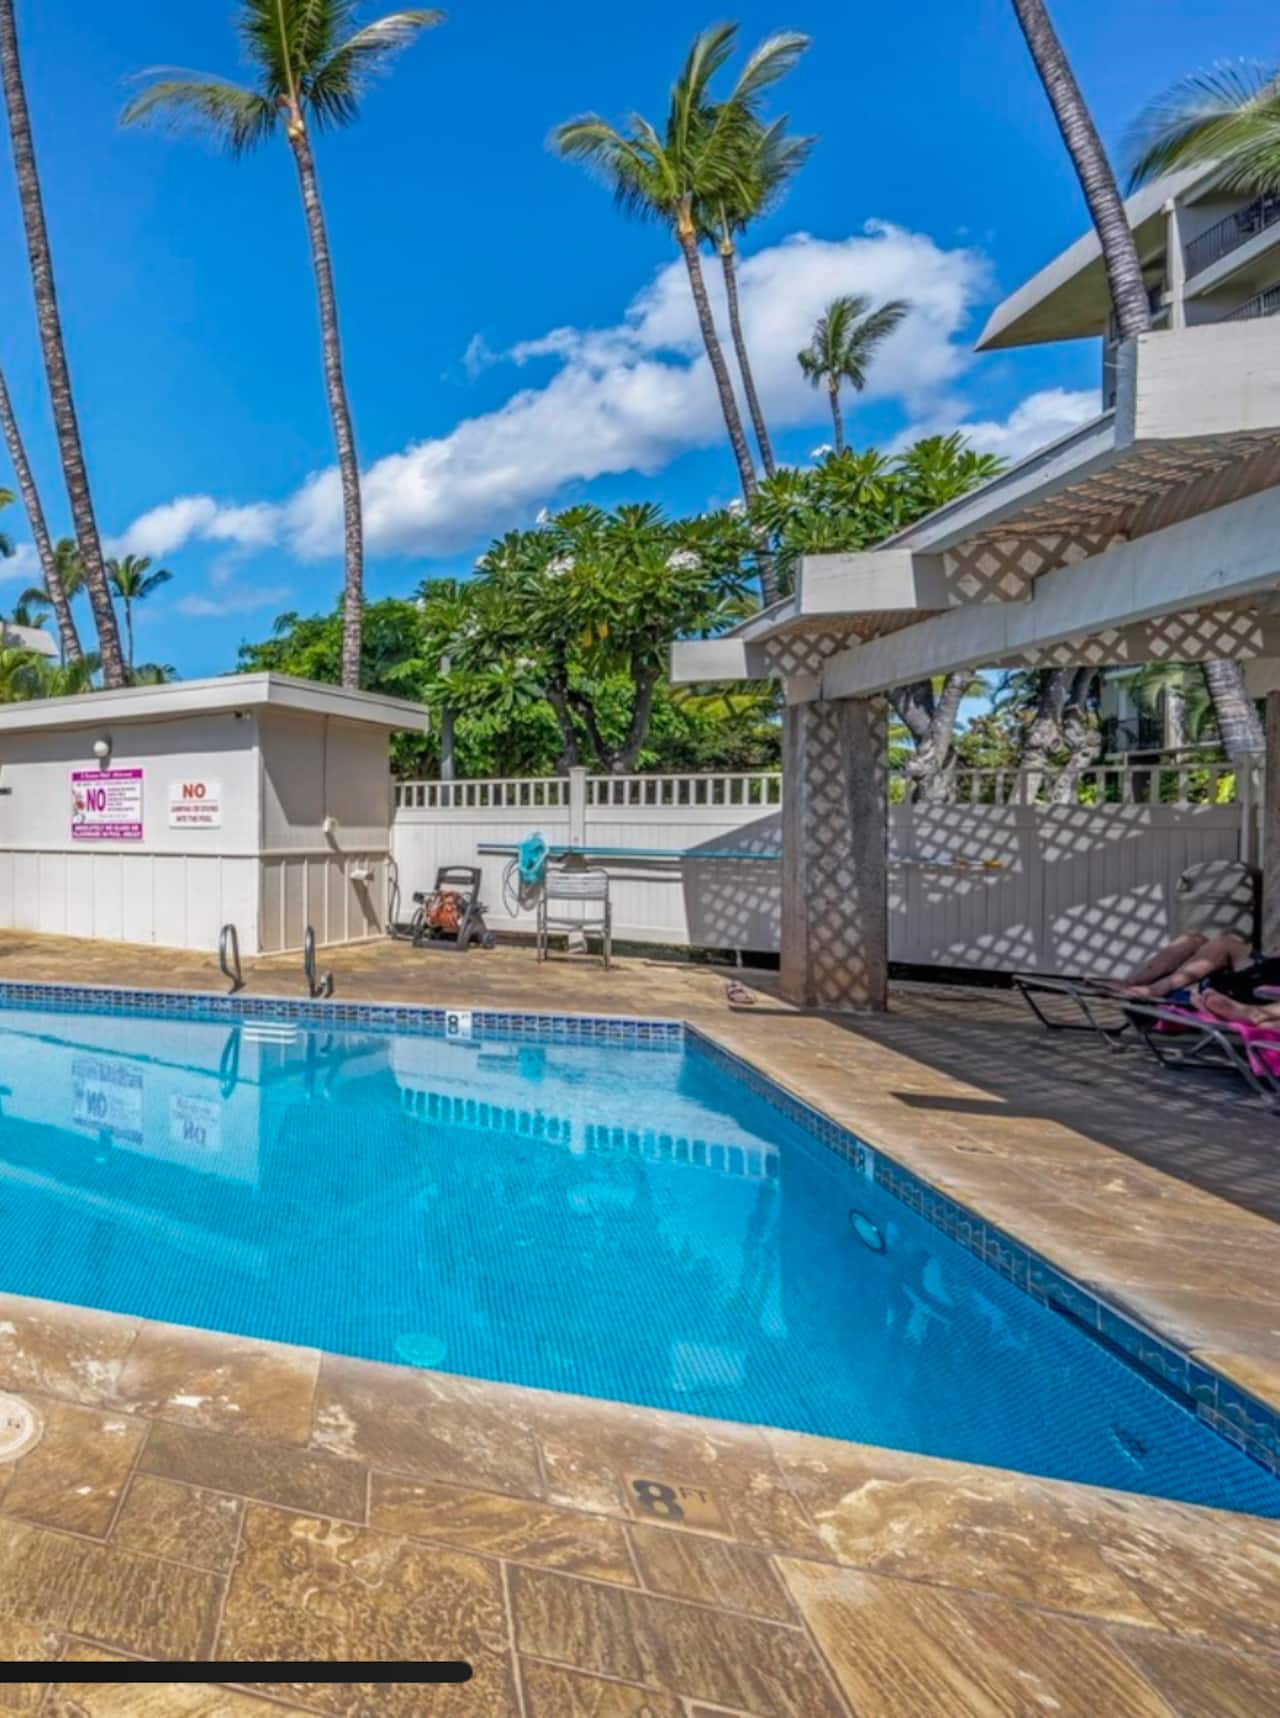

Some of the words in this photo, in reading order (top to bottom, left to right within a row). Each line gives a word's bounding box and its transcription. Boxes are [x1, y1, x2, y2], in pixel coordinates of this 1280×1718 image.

[86, 788, 106, 812] NO
[183, 783, 206, 798] NO
[448, 1014, 459, 1034] 8
[632, 1479, 684, 1520] 8
